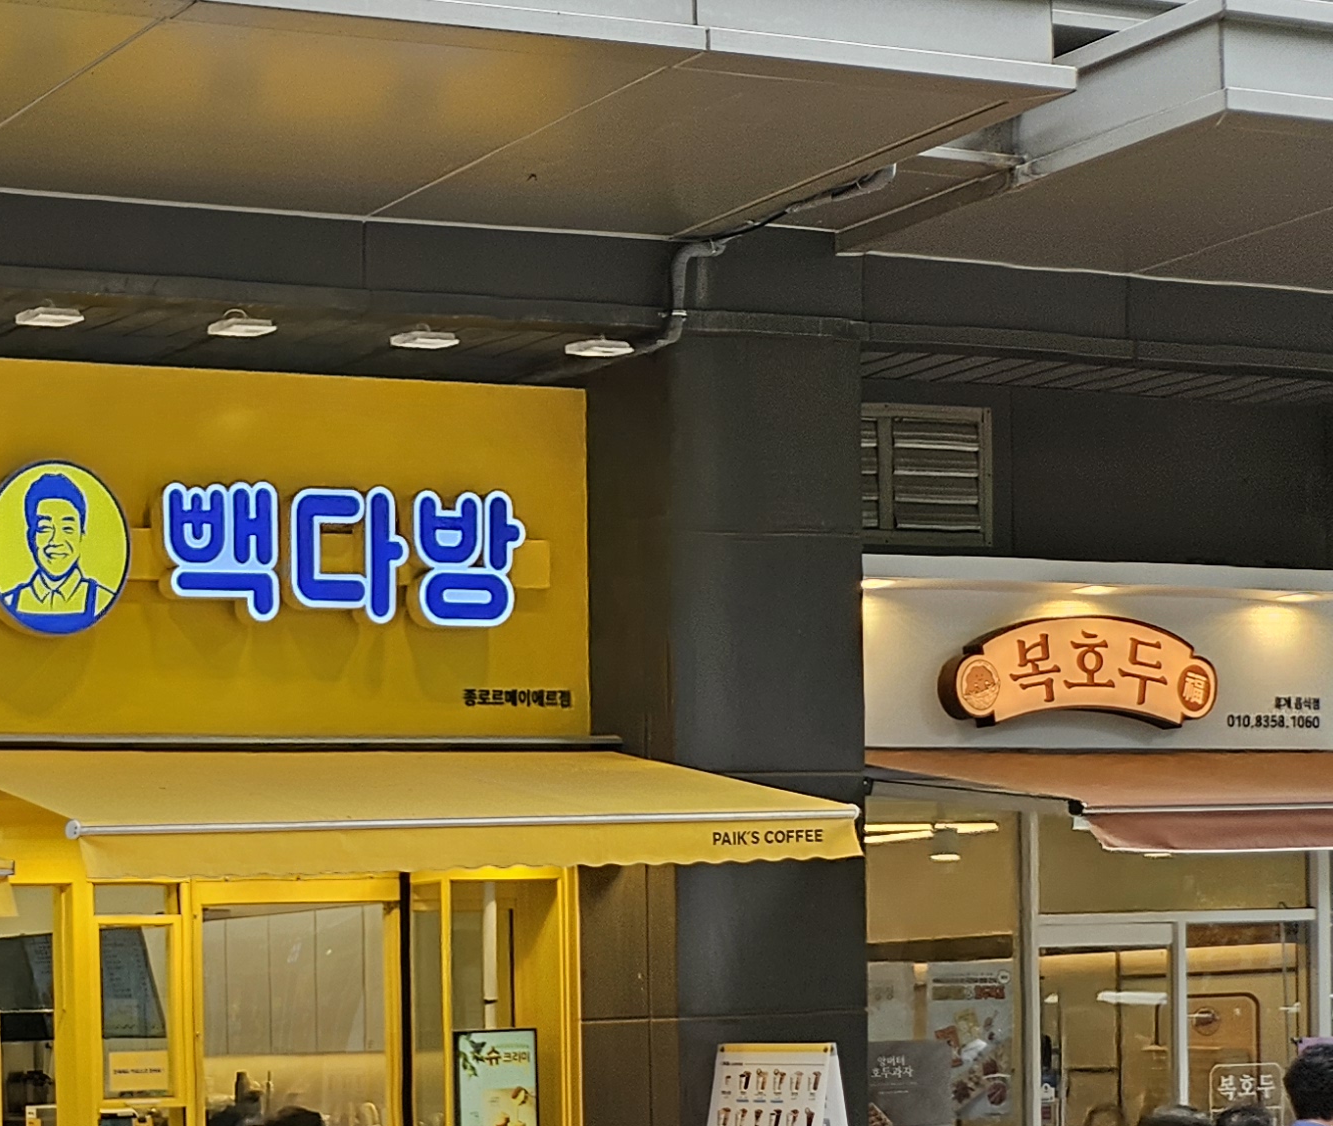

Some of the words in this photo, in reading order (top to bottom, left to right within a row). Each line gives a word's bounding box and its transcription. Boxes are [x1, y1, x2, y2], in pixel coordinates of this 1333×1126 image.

[162, 481, 526, 628] 빽다방
[1009, 630, 1168, 704] 복호두
[713, 831, 760, 845] PAIK'S
[764, 829, 823, 844] COFFEE
[1217, 1074, 1276, 1101] 복호두
